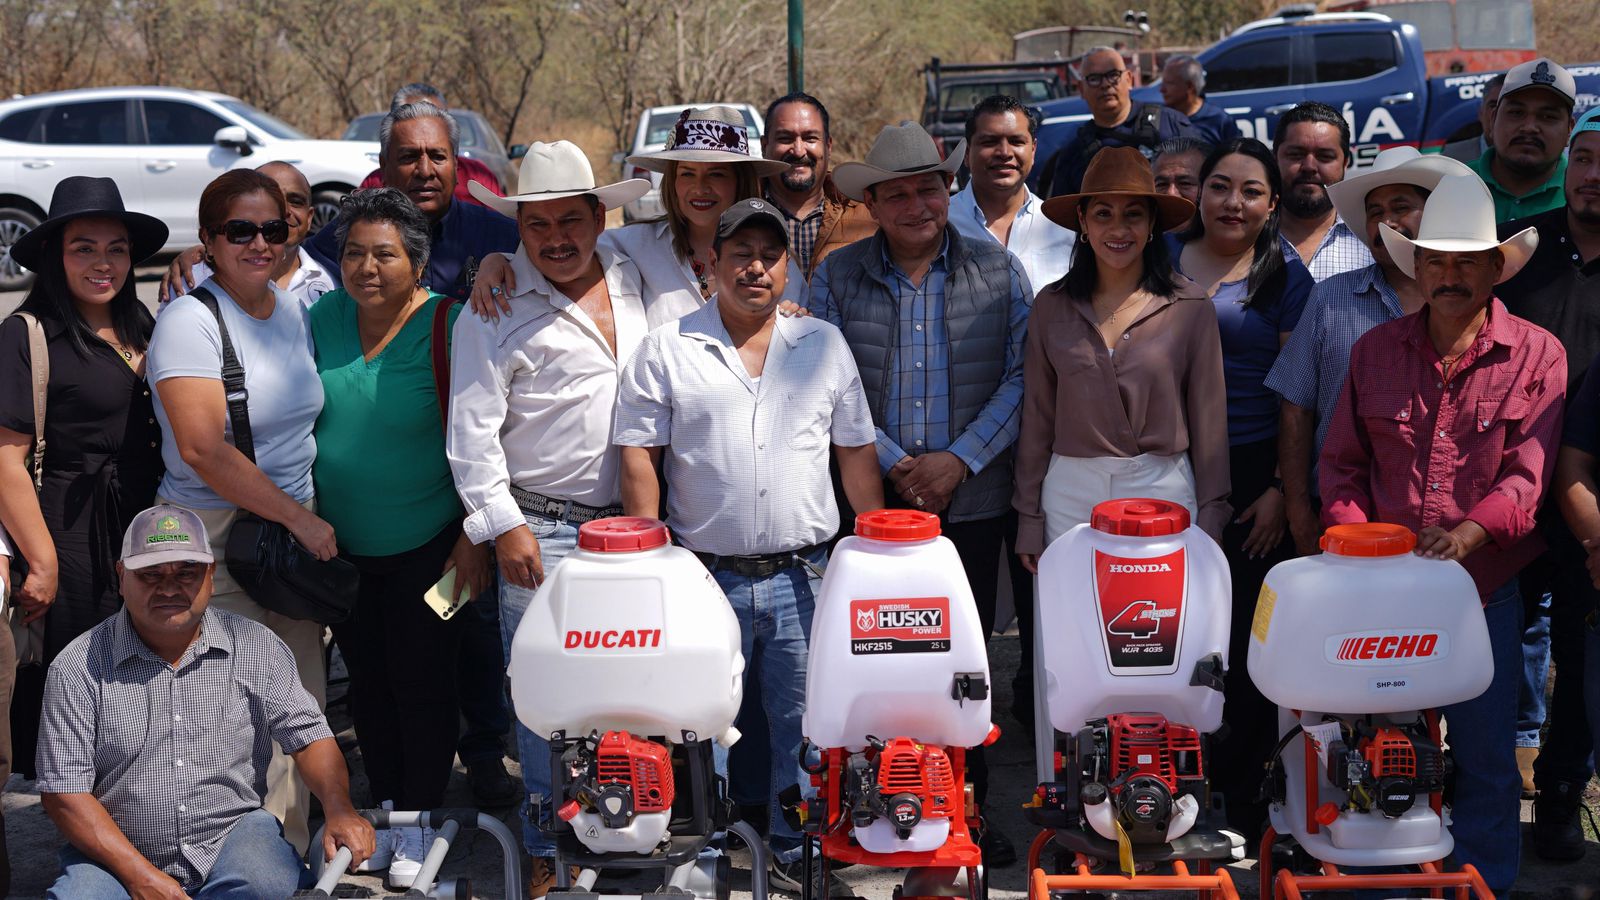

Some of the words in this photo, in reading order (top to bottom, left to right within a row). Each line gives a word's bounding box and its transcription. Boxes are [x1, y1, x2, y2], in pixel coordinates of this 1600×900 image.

[1109, 563, 1172, 573] HONDA
[879, 610, 940, 627] HUSKY
[912, 627, 942, 635] POWER
[564, 629, 661, 649] DUCATI
[854, 642, 893, 652] HKF2515
[941, 641, 946, 649] L
[1358, 634, 1439, 660] ECHO
[1376, 680, 1406, 689] SHP-800
